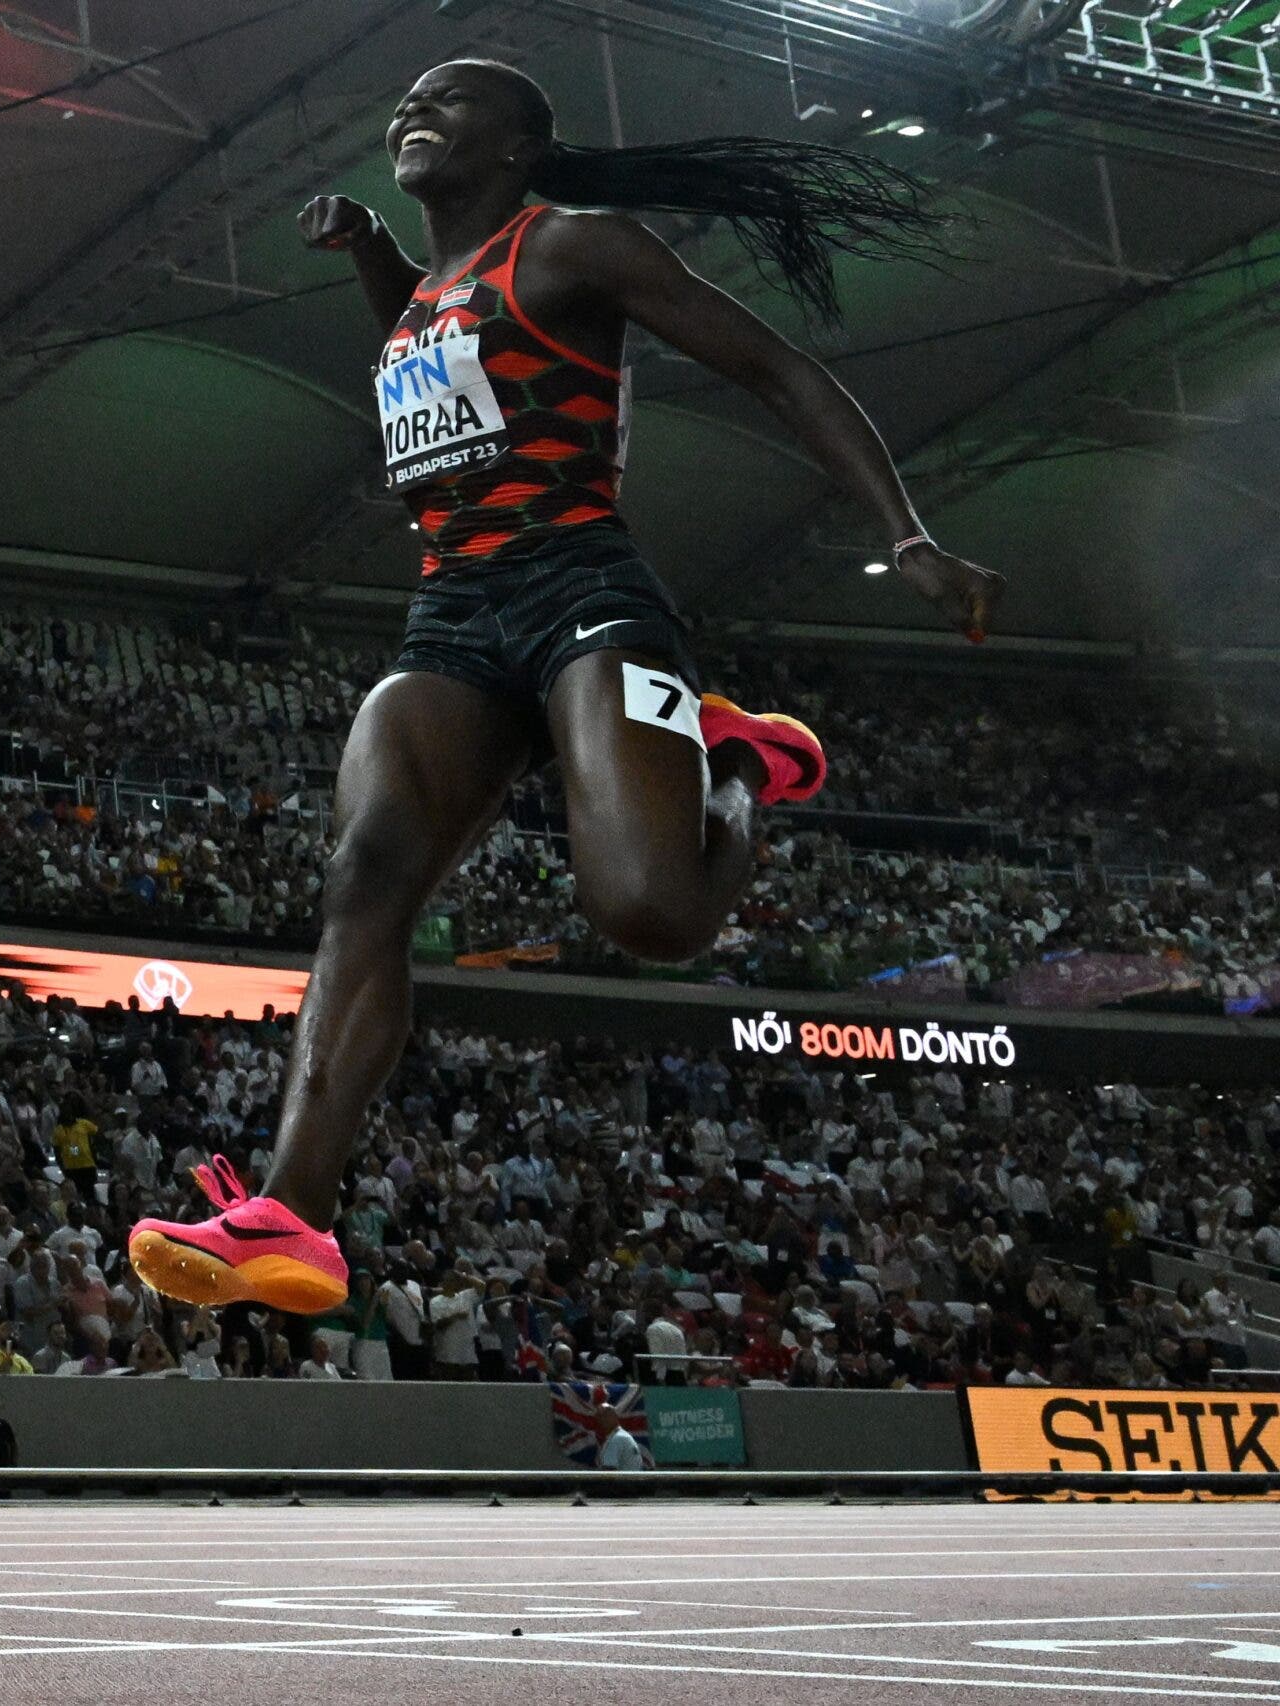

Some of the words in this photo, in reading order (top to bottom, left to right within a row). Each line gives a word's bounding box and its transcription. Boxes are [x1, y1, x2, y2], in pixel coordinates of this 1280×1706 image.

[382, 346, 451, 413] NTN
[395, 447, 471, 484] BUDAPEST
[473, 442, 498, 460] 23
[648, 678, 683, 721] 7
[732, 1010, 792, 1055] NŐI
[799, 1021, 895, 1060] 800M
[898, 1021, 1016, 1068] DÖNTŐ
[659, 1407, 724, 1427] WITNESS
